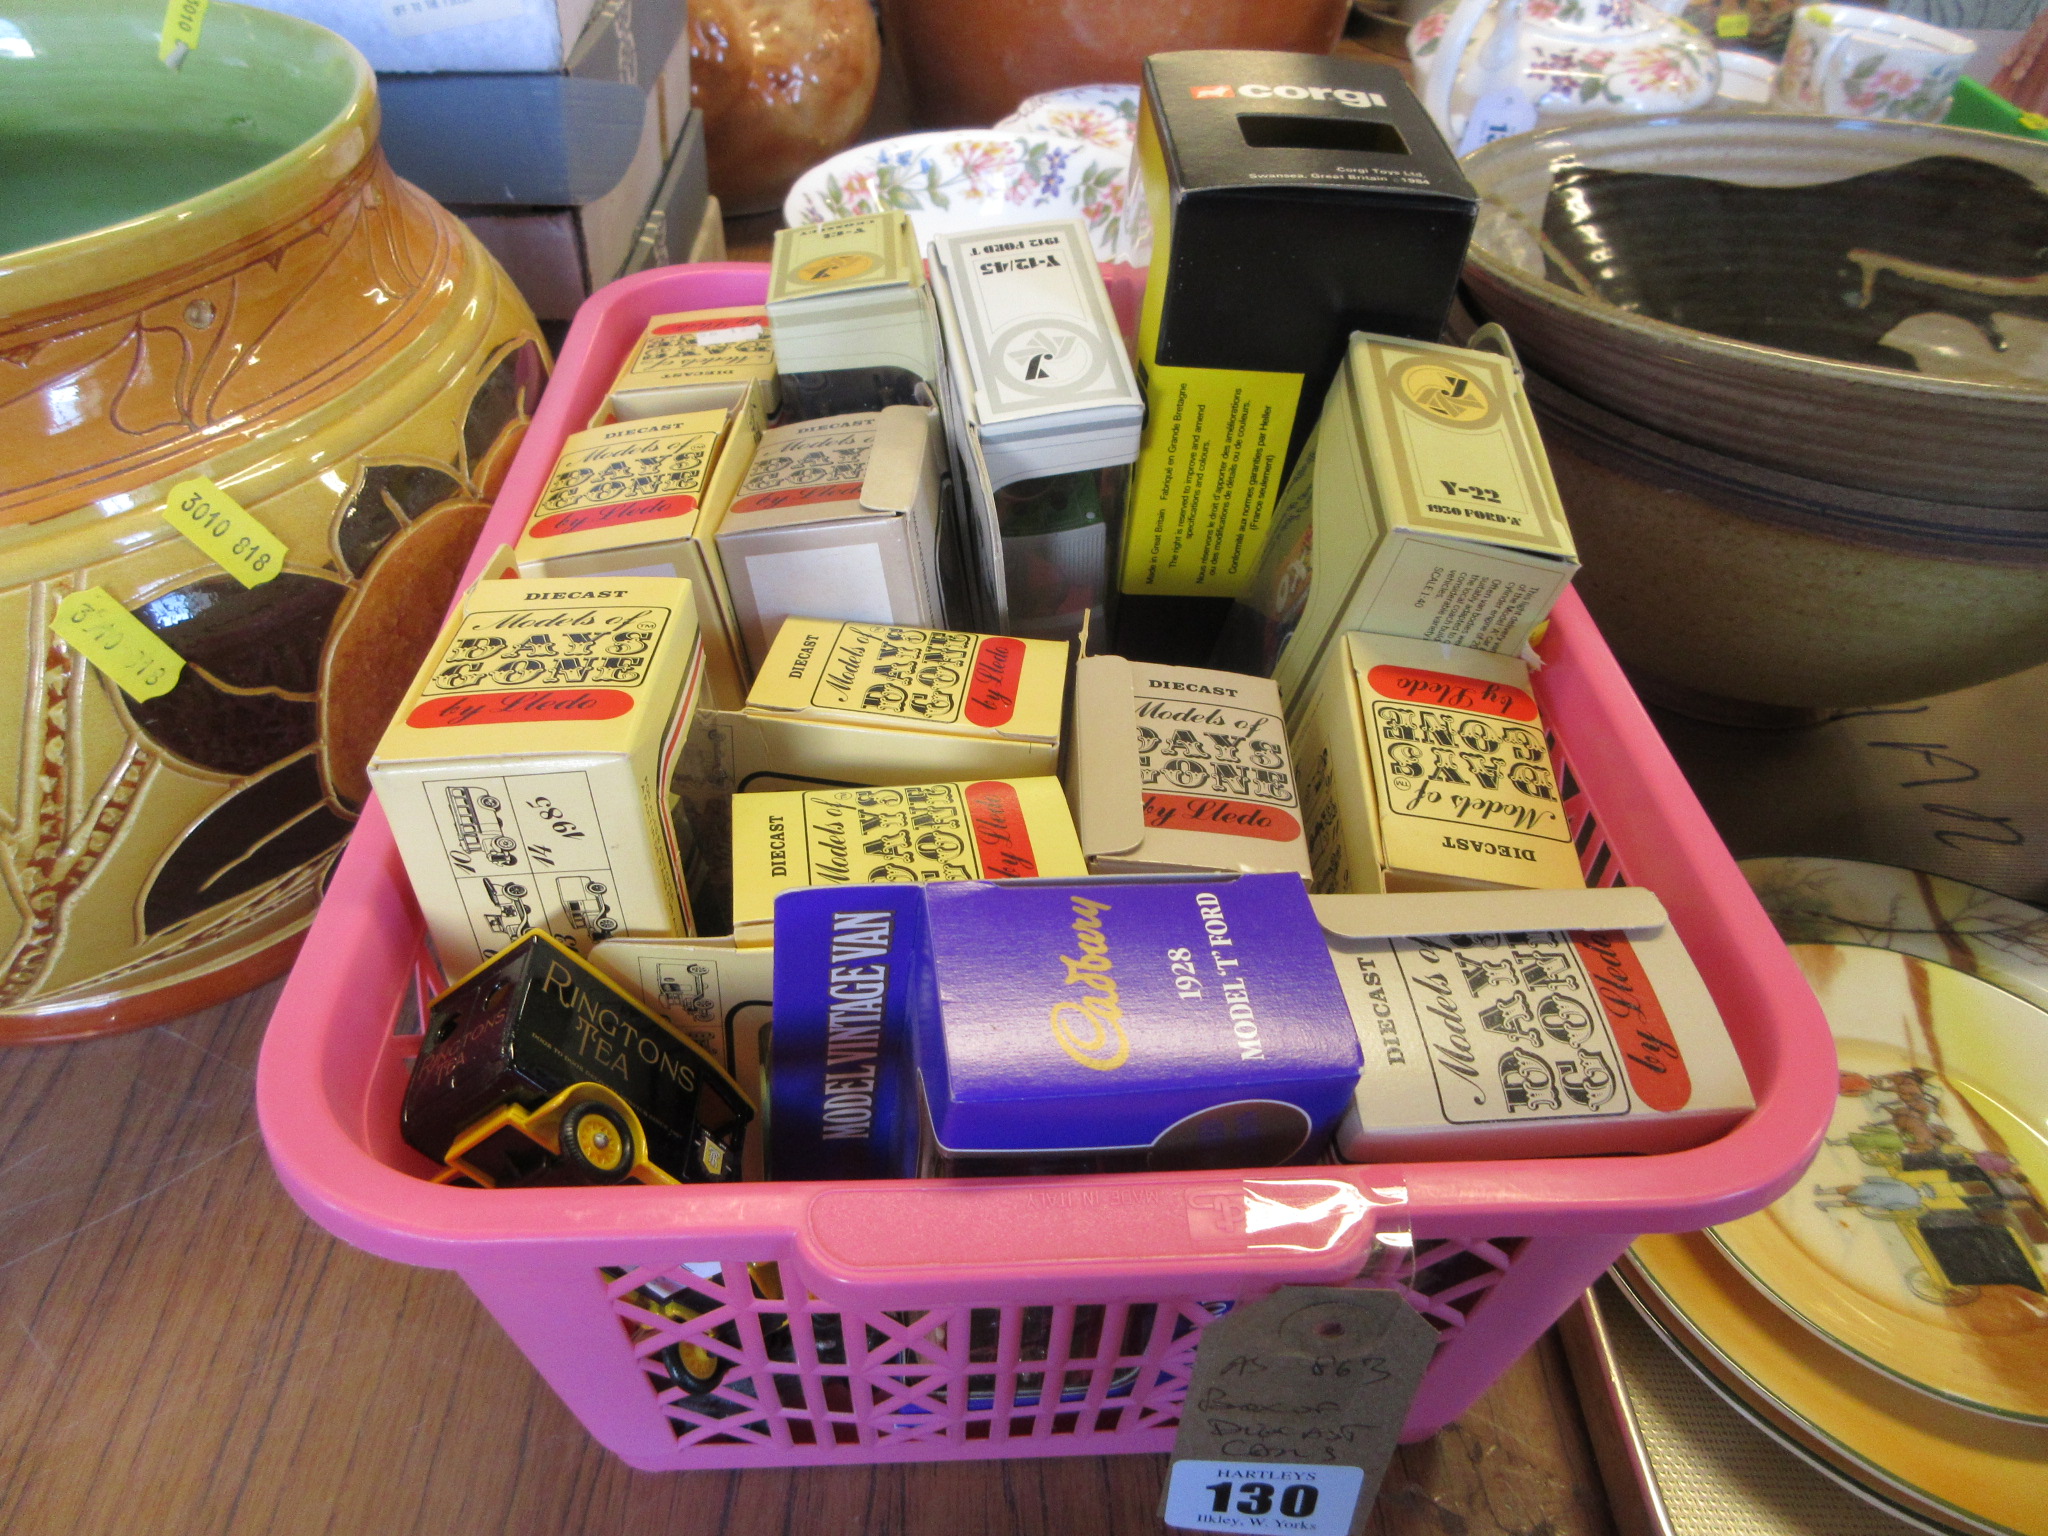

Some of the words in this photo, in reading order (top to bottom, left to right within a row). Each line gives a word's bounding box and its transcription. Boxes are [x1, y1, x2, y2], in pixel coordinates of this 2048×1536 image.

[1238, 84, 1387, 108] corgi
[983, 240, 1025, 253] FORD
[1029, 236, 1060, 247] 1912
[980, 255, 1061, 276] Y-12/45
[1174, 384, 1188, 422] Bretagne
[605, 422, 684, 439] DIECAST
[798, 419, 876, 434] DIECAST
[1195, 405, 1205, 433] amend
[1259, 406, 1272, 431] Heller
[566, 440, 660, 467] Models
[667, 435, 703, 453] of
[763, 434, 855, 457] Models
[1168, 424, 1180, 453] Grande
[1190, 435, 1200, 450] and
[1233, 440, 1242, 449] de
[1257, 434, 1268, 447] par
[550, 451, 705, 492] DAYS
[750, 444, 873, 477] DAY
[1167, 456, 1175, 465] en
[1186, 453, 1196, 484] improve
[1232, 452, 1240, 462] ou
[1248, 448, 1264, 486] garanties
[541, 469, 700, 510] GONE
[744, 463, 866, 491] GON
[1183, 486, 1191, 494] to
[1209, 503, 1219, 520] droit
[1220, 445, 1231, 459] des
[1440, 480, 1503, 504] Y-22
[756, 494, 789, 510] by
[1187, 490, 1201, 540] specifications
[1194, 473, 1204, 488] and
[1223, 491, 1231, 500] de
[1242, 487, 1254, 516] normes
[1426, 504, 1462, 516] 1930
[555, 516, 589, 533] by
[1155, 509, 1166, 533] Britain
[1179, 496, 1188, 527] reserved
[1213, 502, 1230, 551] modifications
[1238, 519, 1247, 531] aux
[1249, 501, 1264, 530] (France
[181, 492, 231, 537] 3010
[231, 536, 271, 571] 818
[1151, 535, 1161, 554] Great
[1172, 537, 1181, 553] right
[1169, 555, 1178, 568] The
[1209, 567, 1216, 576] ou
[1210, 552, 1219, 564] des
[1424, 567, 1444, 591] SCALE
[524, 590, 628, 601] DIECAST
[472, 610, 595, 631] Models
[605, 609, 652, 631] of
[446, 631, 651, 663] DAYS
[788, 634, 820, 680] DIECAST
[433, 656, 644, 690] GONE
[825, 644, 867, 703] Models
[849, 626, 886, 652] of
[861, 627, 927, 713] DAYS
[909, 631, 971, 718] GONE
[972, 681, 1013, 711] by
[1148, 679, 1238, 698] DIECAST
[1483, 683, 1515, 715] by
[439, 697, 485, 724] by
[1134, 701, 1225, 726] Models
[1234, 717, 1269, 738] of
[1136, 726, 1285, 769] DAYS
[1378, 706, 1545, 763] GONE
[1388, 742, 1557, 803] DAYS
[810, 797, 857, 818] of
[1406, 780, 1443, 810] of
[526, 796, 585, 840] 1985
[1143, 796, 1176, 826] by
[1451, 795, 1556, 830] Models
[528, 843, 555, 867] 14
[769, 815, 787, 877] DIECAST
[812, 823, 850, 885] Models
[1442, 835, 1537, 862] DIECAST
[449, 850, 476, 875] 10
[988, 849, 1035, 881] by
[1196, 892, 1233, 947] FORD
[831, 911, 893, 964] VAN
[1049, 894, 1131, 1071] Cadbury
[1167, 947, 1203, 1001] 1928
[541, 960, 696, 1093] RINGTONS
[827, 964, 887, 1066] VINTAGE
[1222, 977, 1265, 1061] MODEL
[1358, 957, 1406, 1066] DIECAST
[576, 1014, 630, 1082] TEA
[1412, 973, 1487, 1106] Models
[1627, 1030, 1680, 1074] by
[822, 1064, 876, 1140] MODEL
[1217, 1469, 1317, 1481] HARTLEYS
[1206, 1481, 1319, 1518] 130
[1248, 1517, 1268, 1529] W.
[1274, 1517, 1317, 1530] Yorks
